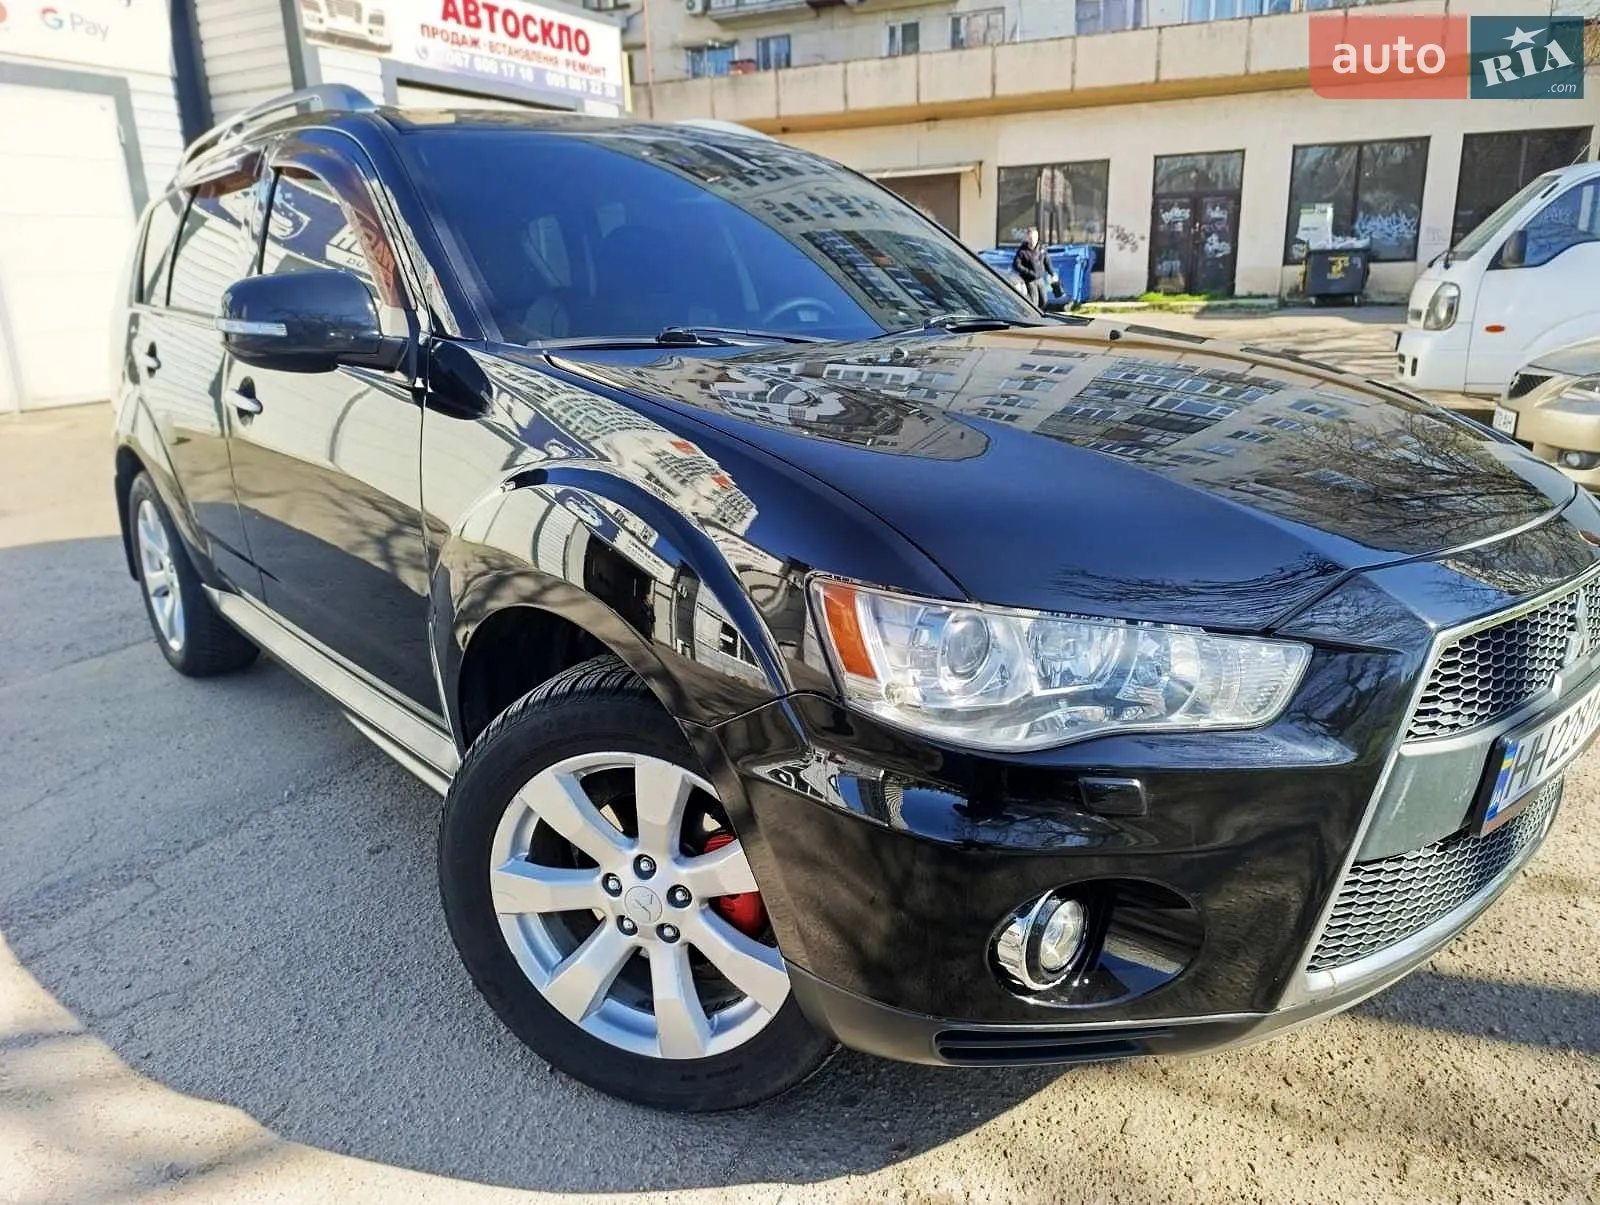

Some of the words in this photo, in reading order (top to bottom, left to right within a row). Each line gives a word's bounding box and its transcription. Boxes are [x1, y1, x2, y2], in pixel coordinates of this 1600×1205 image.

[40, 6, 64, 30] G
[69, 12, 110, 41] Pay
[442, 0, 590, 56] АВТОСКЛО
[420, 24, 480, 49] ПРОДАЖ
[488, 41, 558, 64] ВСТАНОВЛЕННЯ
[565, 58, 606, 77] РЕМОНТ
